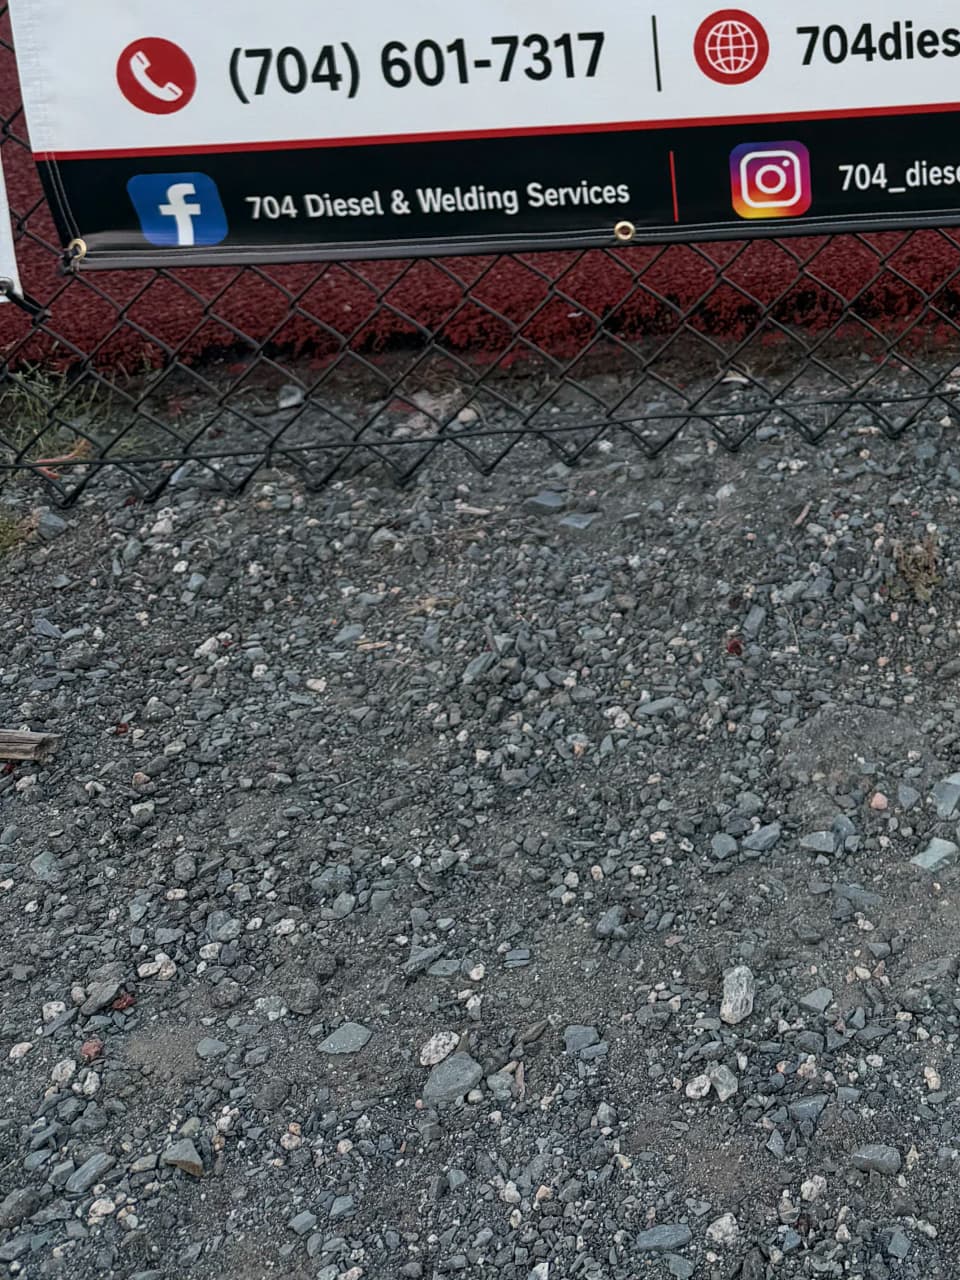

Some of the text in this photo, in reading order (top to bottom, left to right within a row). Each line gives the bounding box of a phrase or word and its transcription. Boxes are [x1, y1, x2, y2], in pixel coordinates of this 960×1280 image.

[228, 31, 605, 104] (704) 601-7317
[245, 180, 631, 220] 704 Diesel & Welding Services
